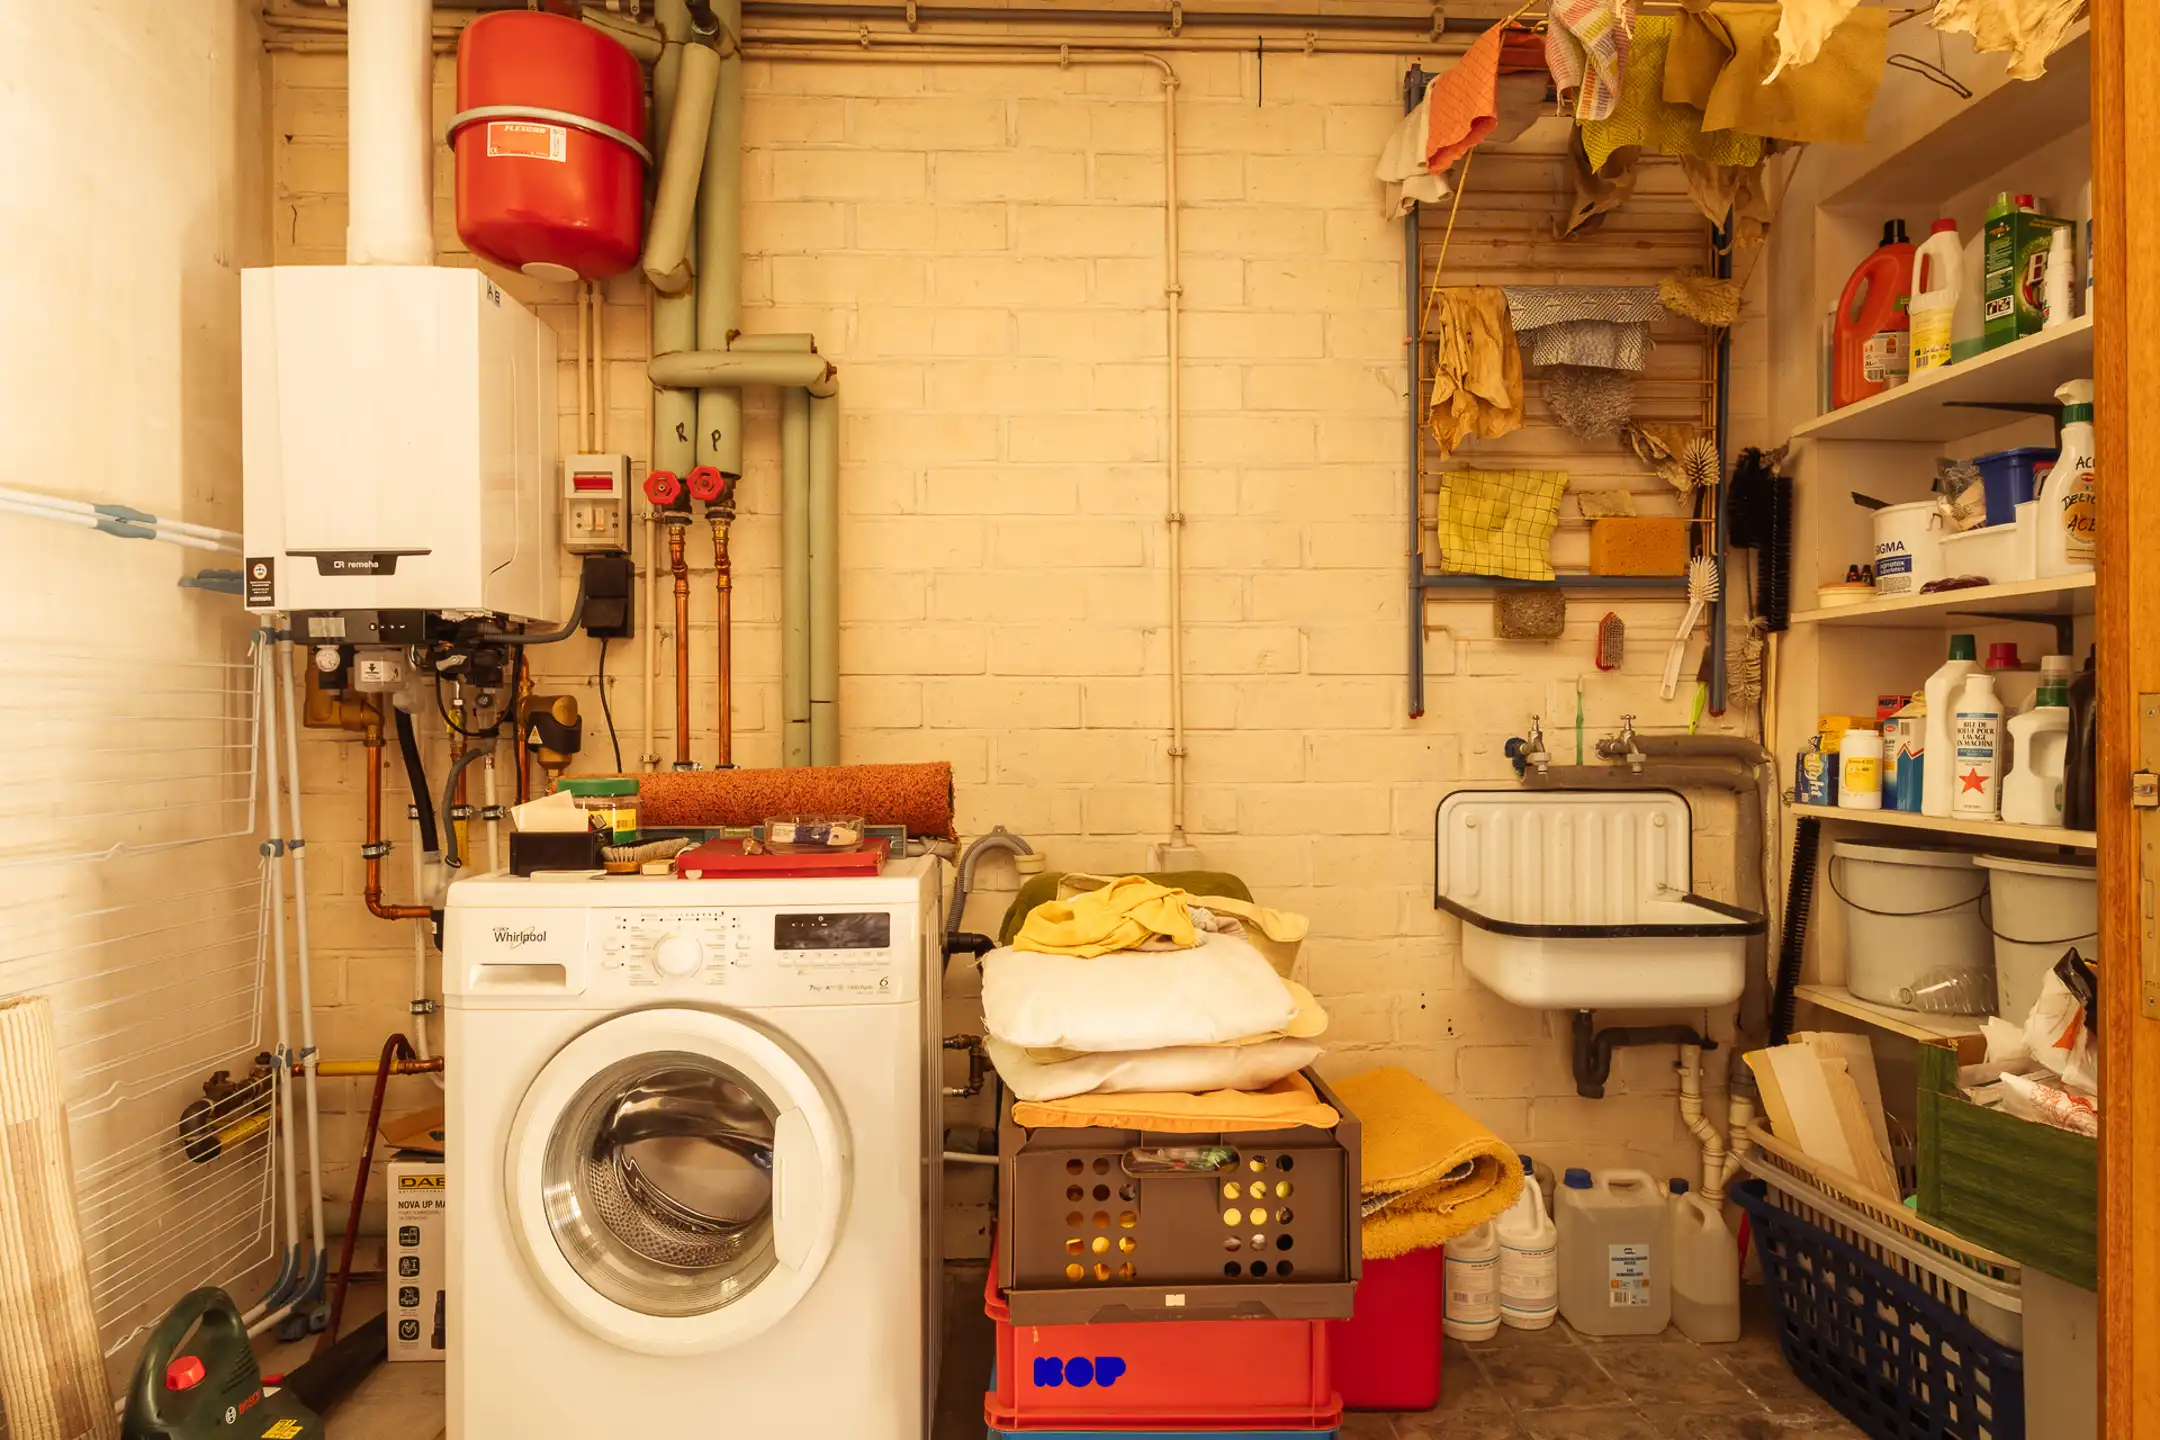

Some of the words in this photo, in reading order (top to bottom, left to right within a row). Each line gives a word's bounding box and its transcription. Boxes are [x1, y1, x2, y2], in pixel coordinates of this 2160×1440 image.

[676, 422, 688, 443] R
[711, 429, 722, 452] P
[1875, 540, 1905, 555] SIGMA
[347, 560, 379, 569] remeha
[493, 930, 547, 945] Whirlpool
[398, 1200, 420, 1209] NOVA
[422, 1200, 433, 1209] UP
